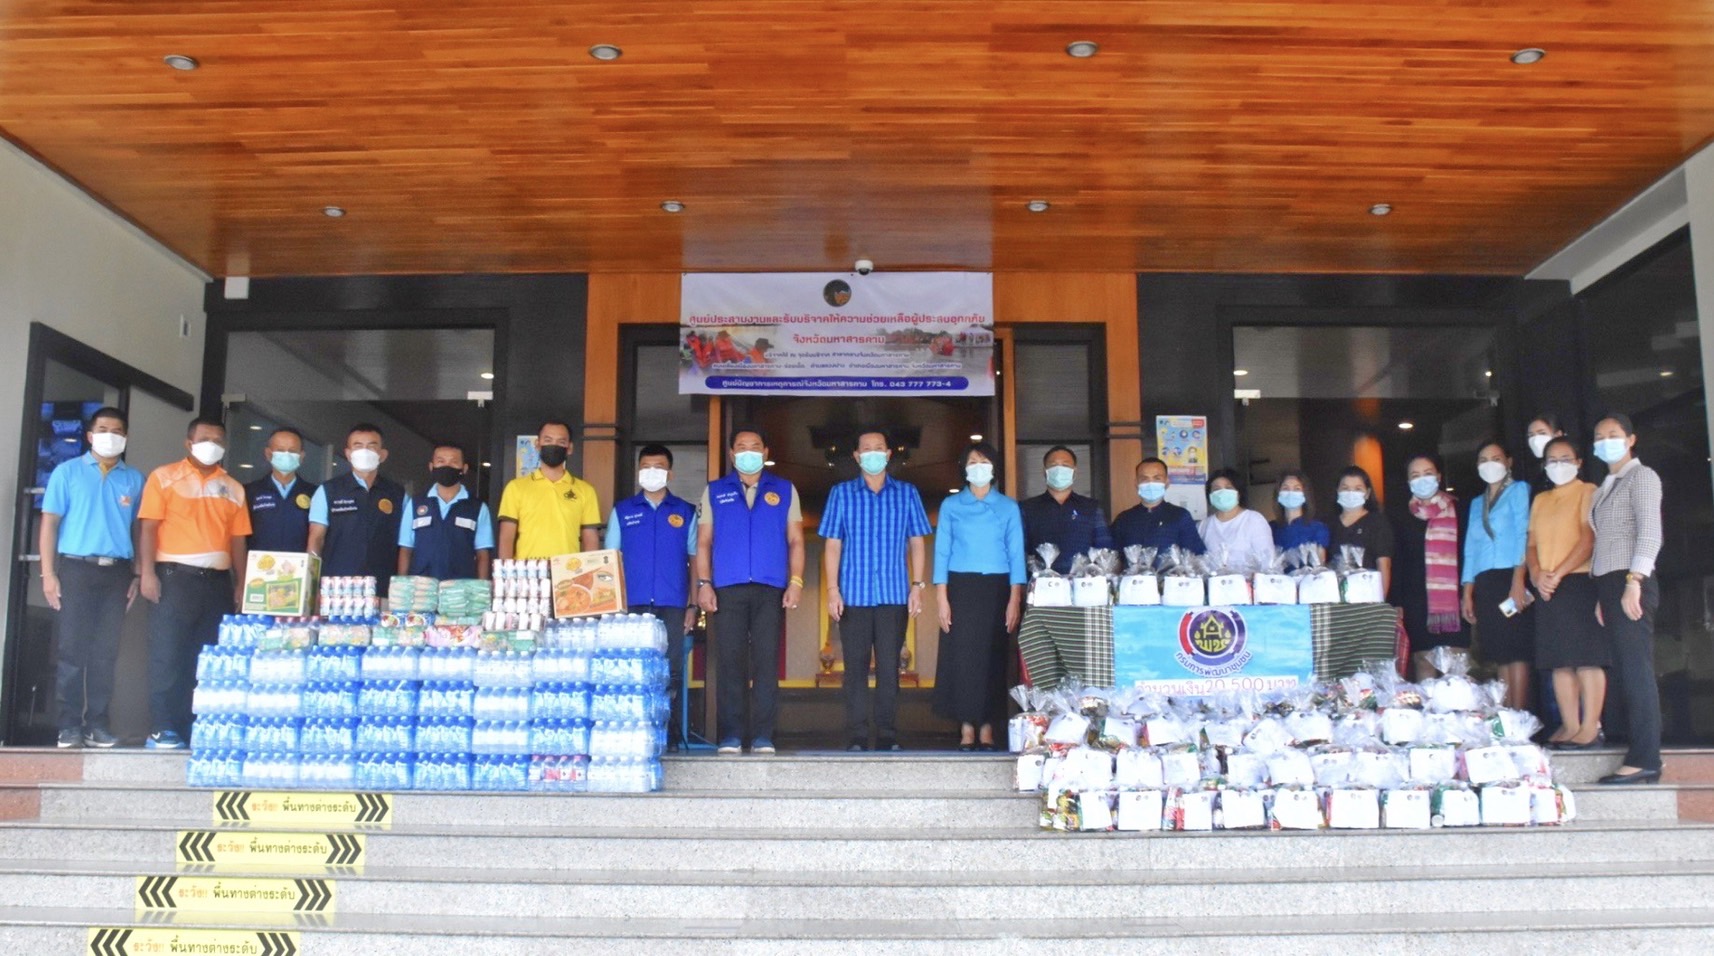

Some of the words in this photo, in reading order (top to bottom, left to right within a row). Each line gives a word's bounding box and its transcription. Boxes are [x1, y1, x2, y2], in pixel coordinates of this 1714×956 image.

[793, 333, 885, 344] จังหวัดมหาสารคาม
[1176, 651, 1251, 676] กรมการพัฒนาชุมชน
[282, 796, 357, 812] พื้นทางต่างระดับ
[249, 836, 328, 854] พื้นทางต่างระดับ
[213, 881, 295, 900] พื้นทางต่างระดับ
[170, 935, 258, 955] พื้นทางต่างระดับ
